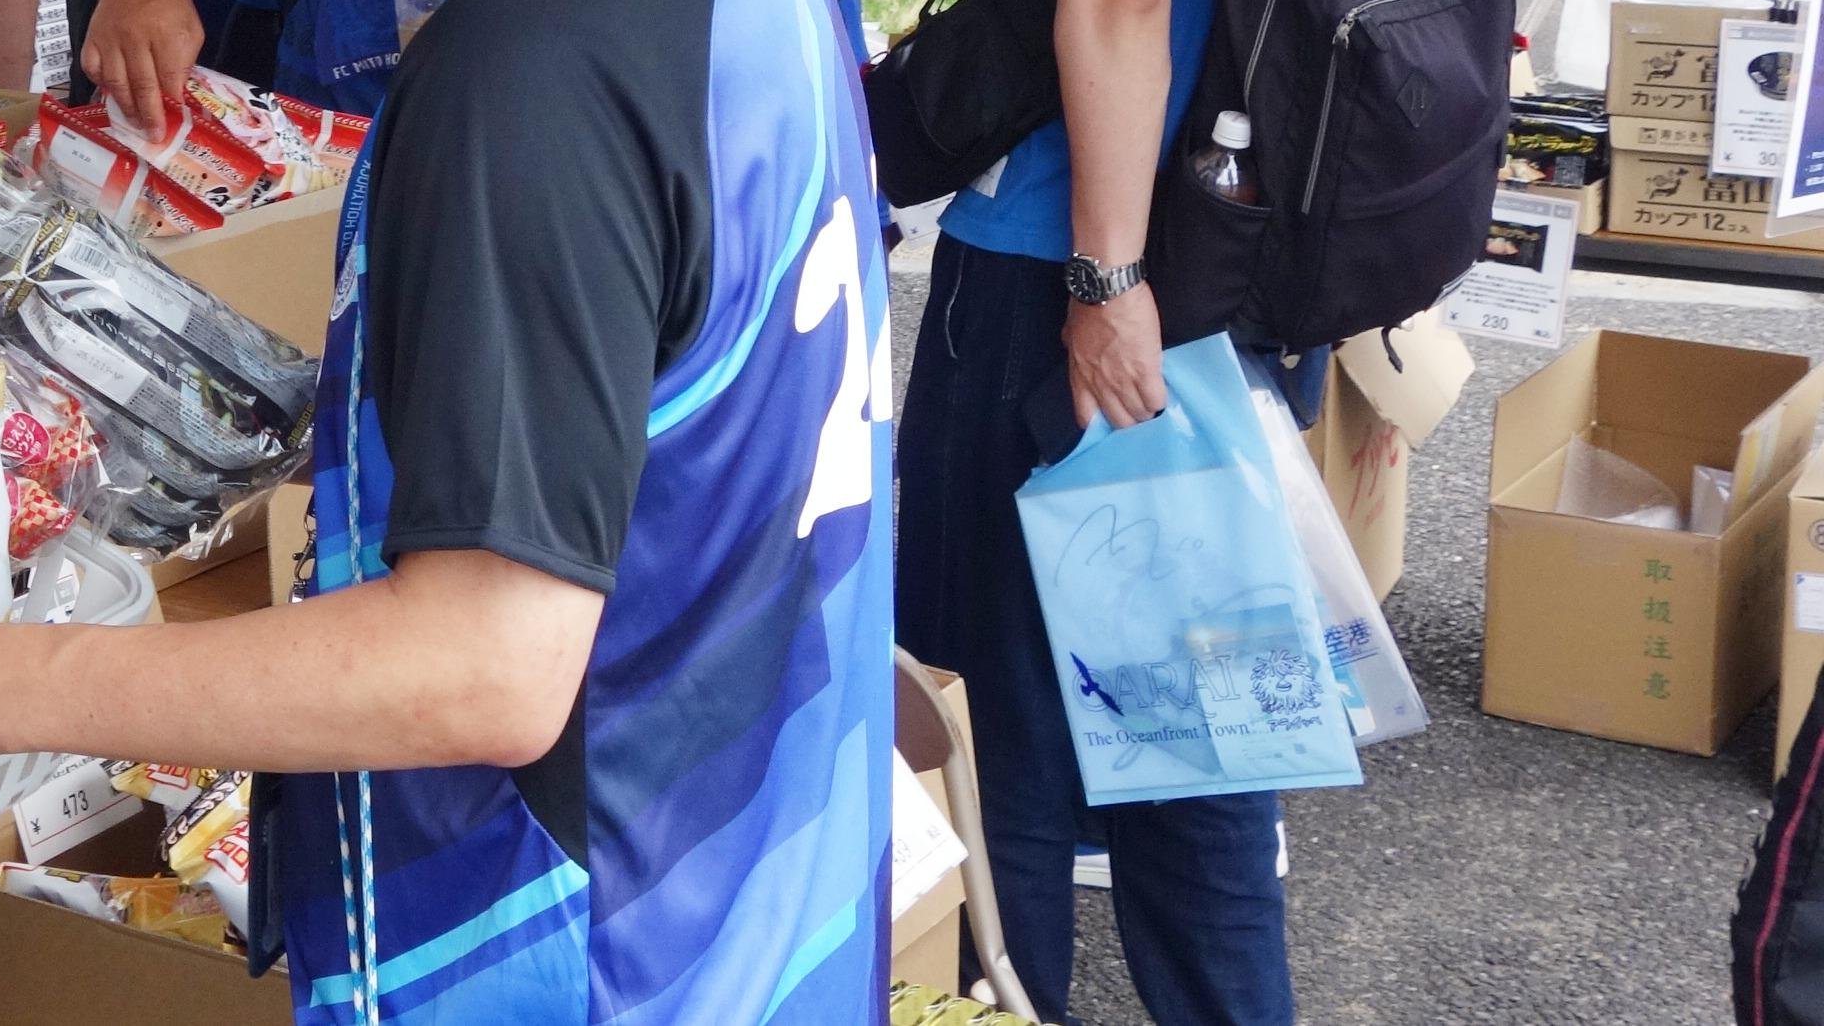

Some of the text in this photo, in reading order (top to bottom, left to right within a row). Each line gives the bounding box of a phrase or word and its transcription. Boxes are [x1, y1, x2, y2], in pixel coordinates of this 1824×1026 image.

[332, 64, 352, 80] FC
[1632, 90, 1696, 109] カップ
[344, 158, 373, 230] HOLLYHOCK
[1634, 209, 1697, 227] カップ
[1482, 313, 1509, 330] 230
[1073, 653, 1241, 719] OARAI
[1083, 730, 1113, 747] The
[1115, 723, 1200, 745] Oceanfront
[30, 789, 90, 835] ¥ 473
